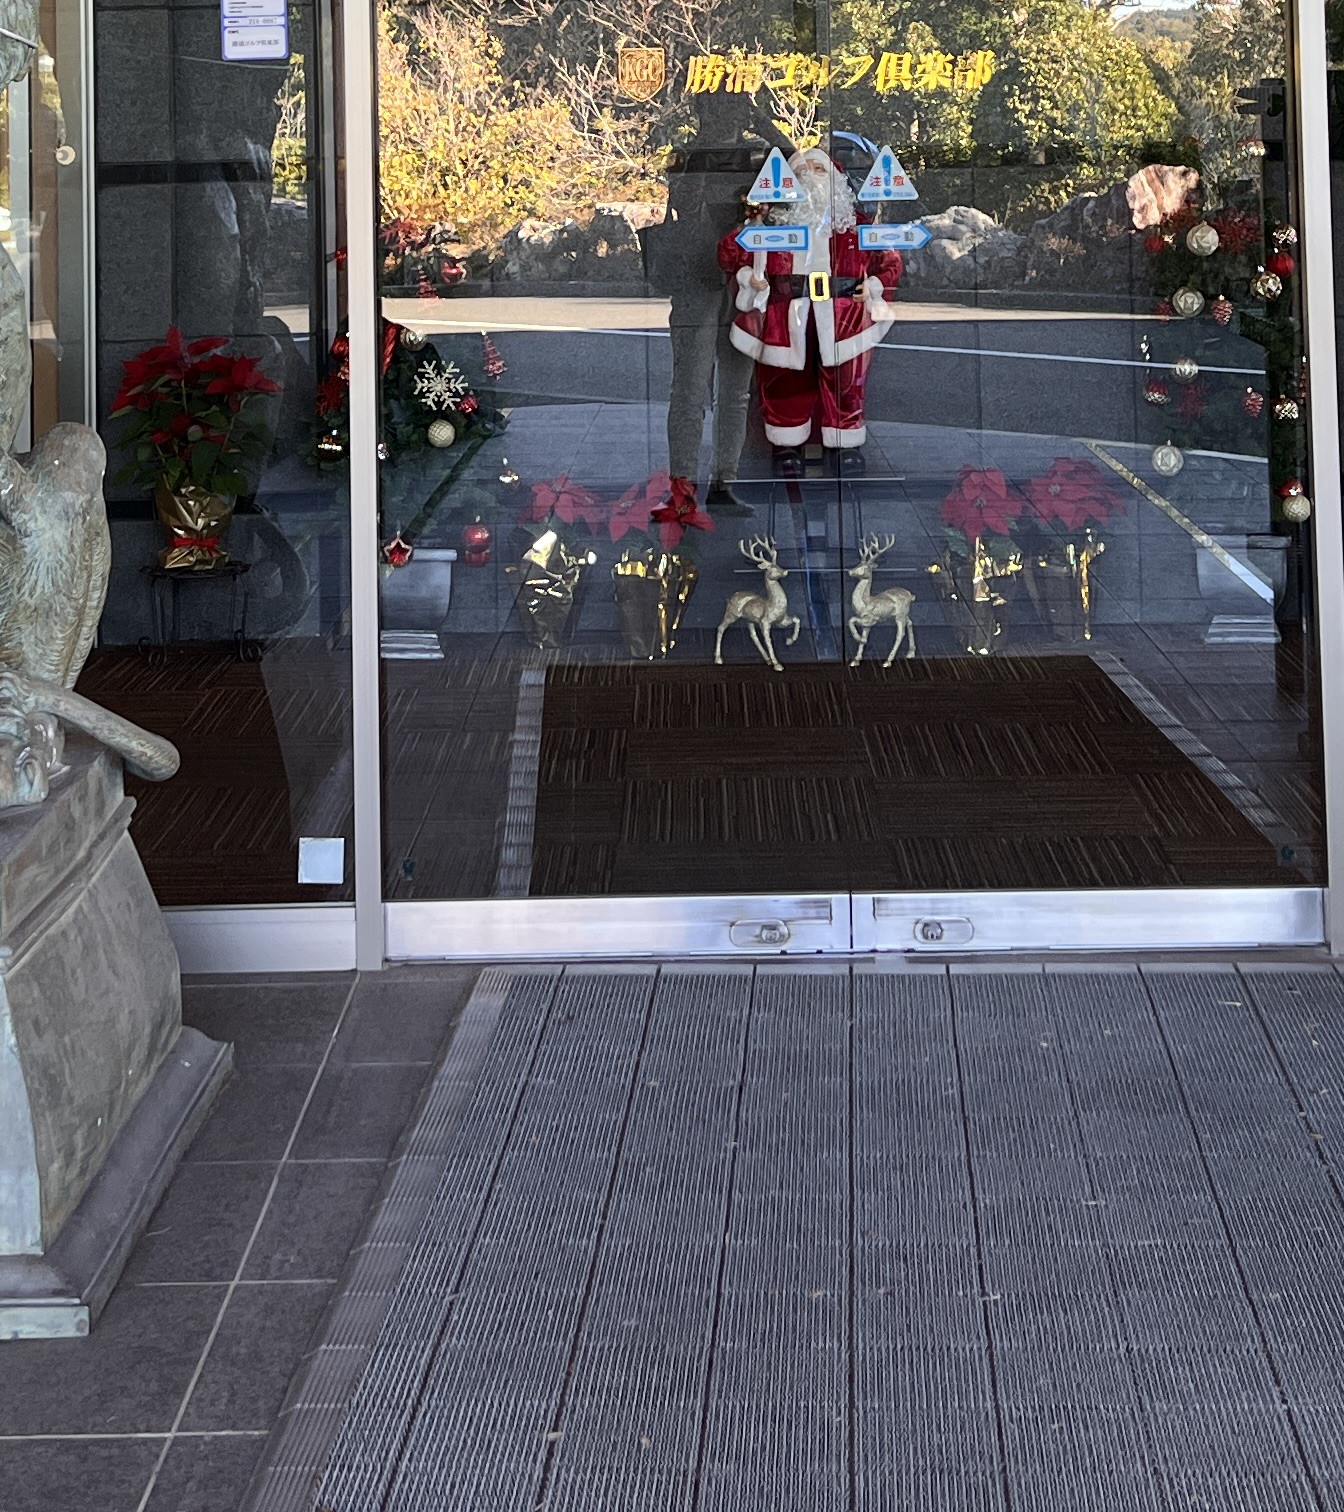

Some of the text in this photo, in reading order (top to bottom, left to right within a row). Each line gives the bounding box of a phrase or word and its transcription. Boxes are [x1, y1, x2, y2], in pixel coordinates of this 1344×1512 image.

[685, 49, 995, 94] 勝浦ゴルフ倶楽部
